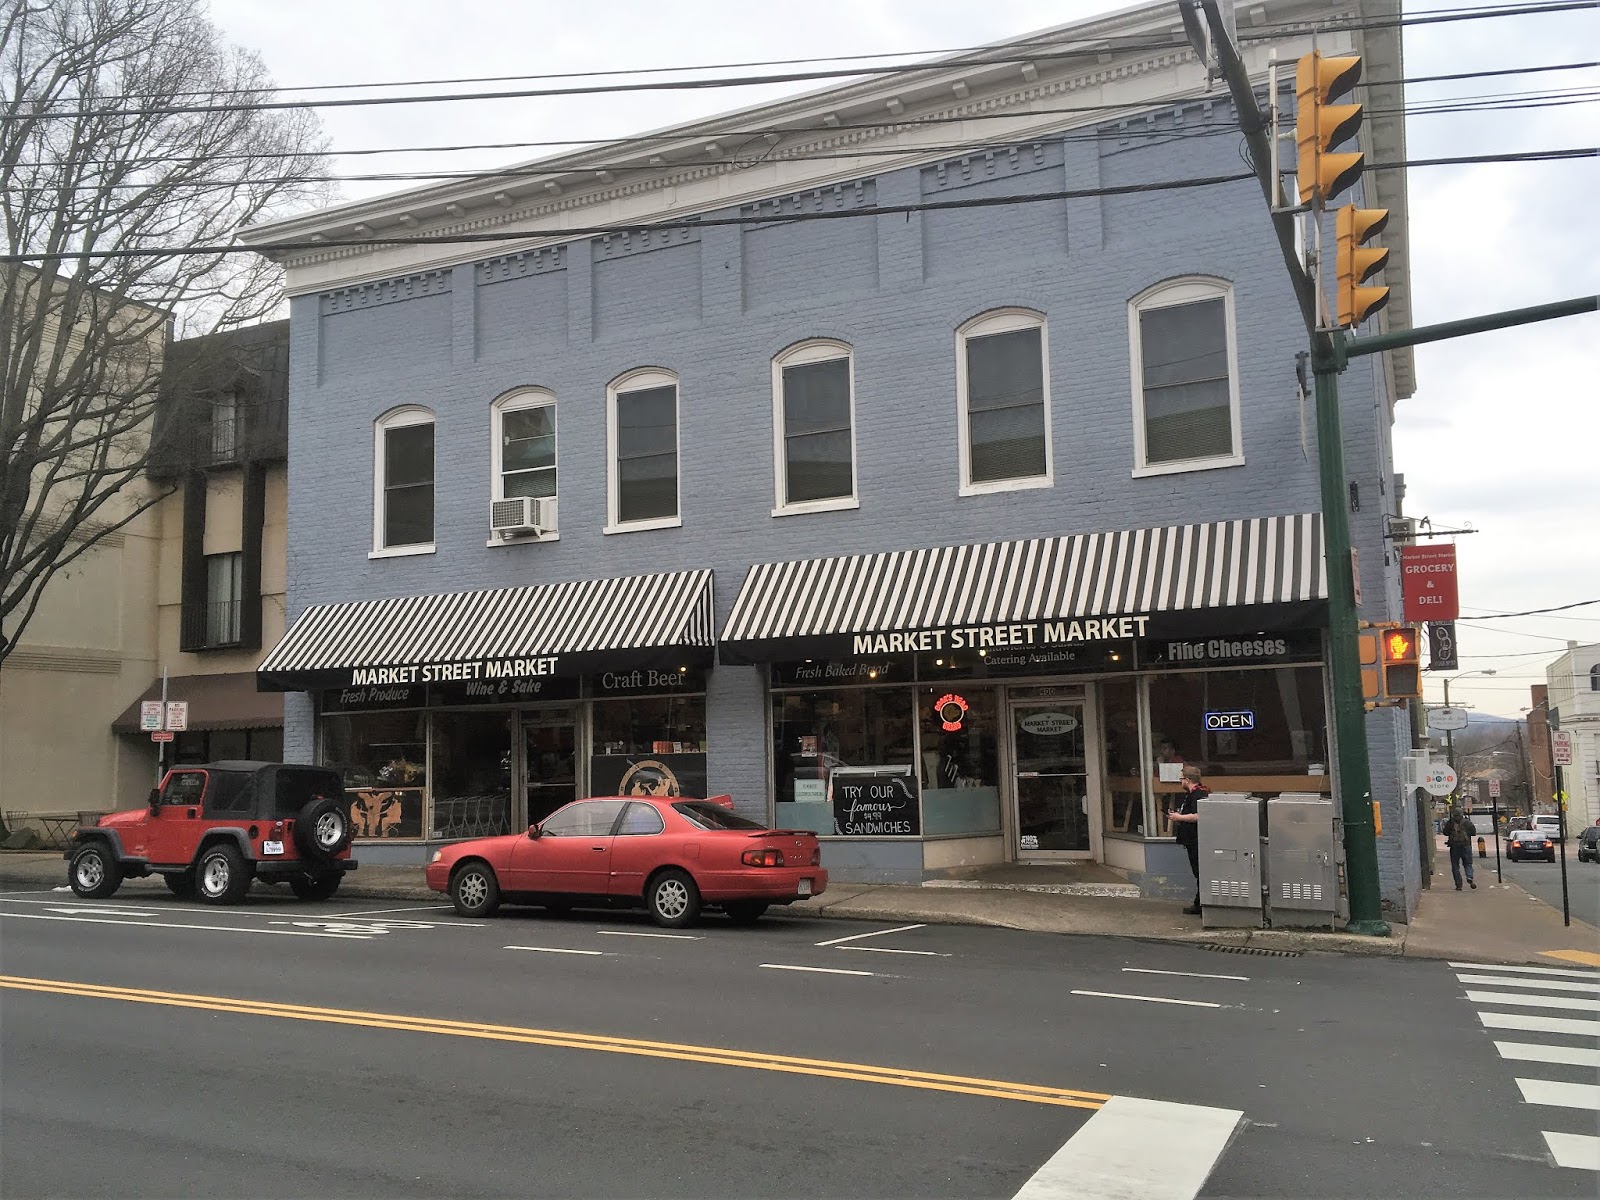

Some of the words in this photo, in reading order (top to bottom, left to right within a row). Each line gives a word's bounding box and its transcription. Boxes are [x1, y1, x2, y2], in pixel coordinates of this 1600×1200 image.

[1405, 564, 1454, 574] GROCERY
[1427, 580, 1434, 588] &
[1419, 596, 1442, 604] DELI
[853, 630, 946, 655] MARKET
[950, 624, 1038, 649] STREET
[1044, 616, 1149, 644] MARKET
[1168, 642, 1204, 660] Fine
[1208, 639, 1286, 657] Cheeses
[984, 654, 1026, 665] Catering
[1028, 651, 1075, 662] Available
[352, 664, 419, 686] MARKET
[422, 661, 482, 682] STREET
[485, 656, 558, 678] MARKET
[796, 665, 822, 679] Fresh
[825, 663, 857, 677] Baked
[602, 670, 643, 689] Craft
[647, 669, 685, 687] Beer
[466, 681, 494, 696] Wine
[498, 682, 508, 694] &
[512, 680, 541, 694] Sake
[1039, 688, 1056, 696] 400
[340, 688, 365, 704] Fresh
[368, 687, 409, 702] Produce
[1208, 715, 1252, 727] OPEN
[842, 786, 863, 798] TRY
[870, 785, 894, 798] OUR
[843, 798, 906, 822] famous
[864, 812, 882, 821] $4.99
[845, 820, 911, 834] SANDWICHES
